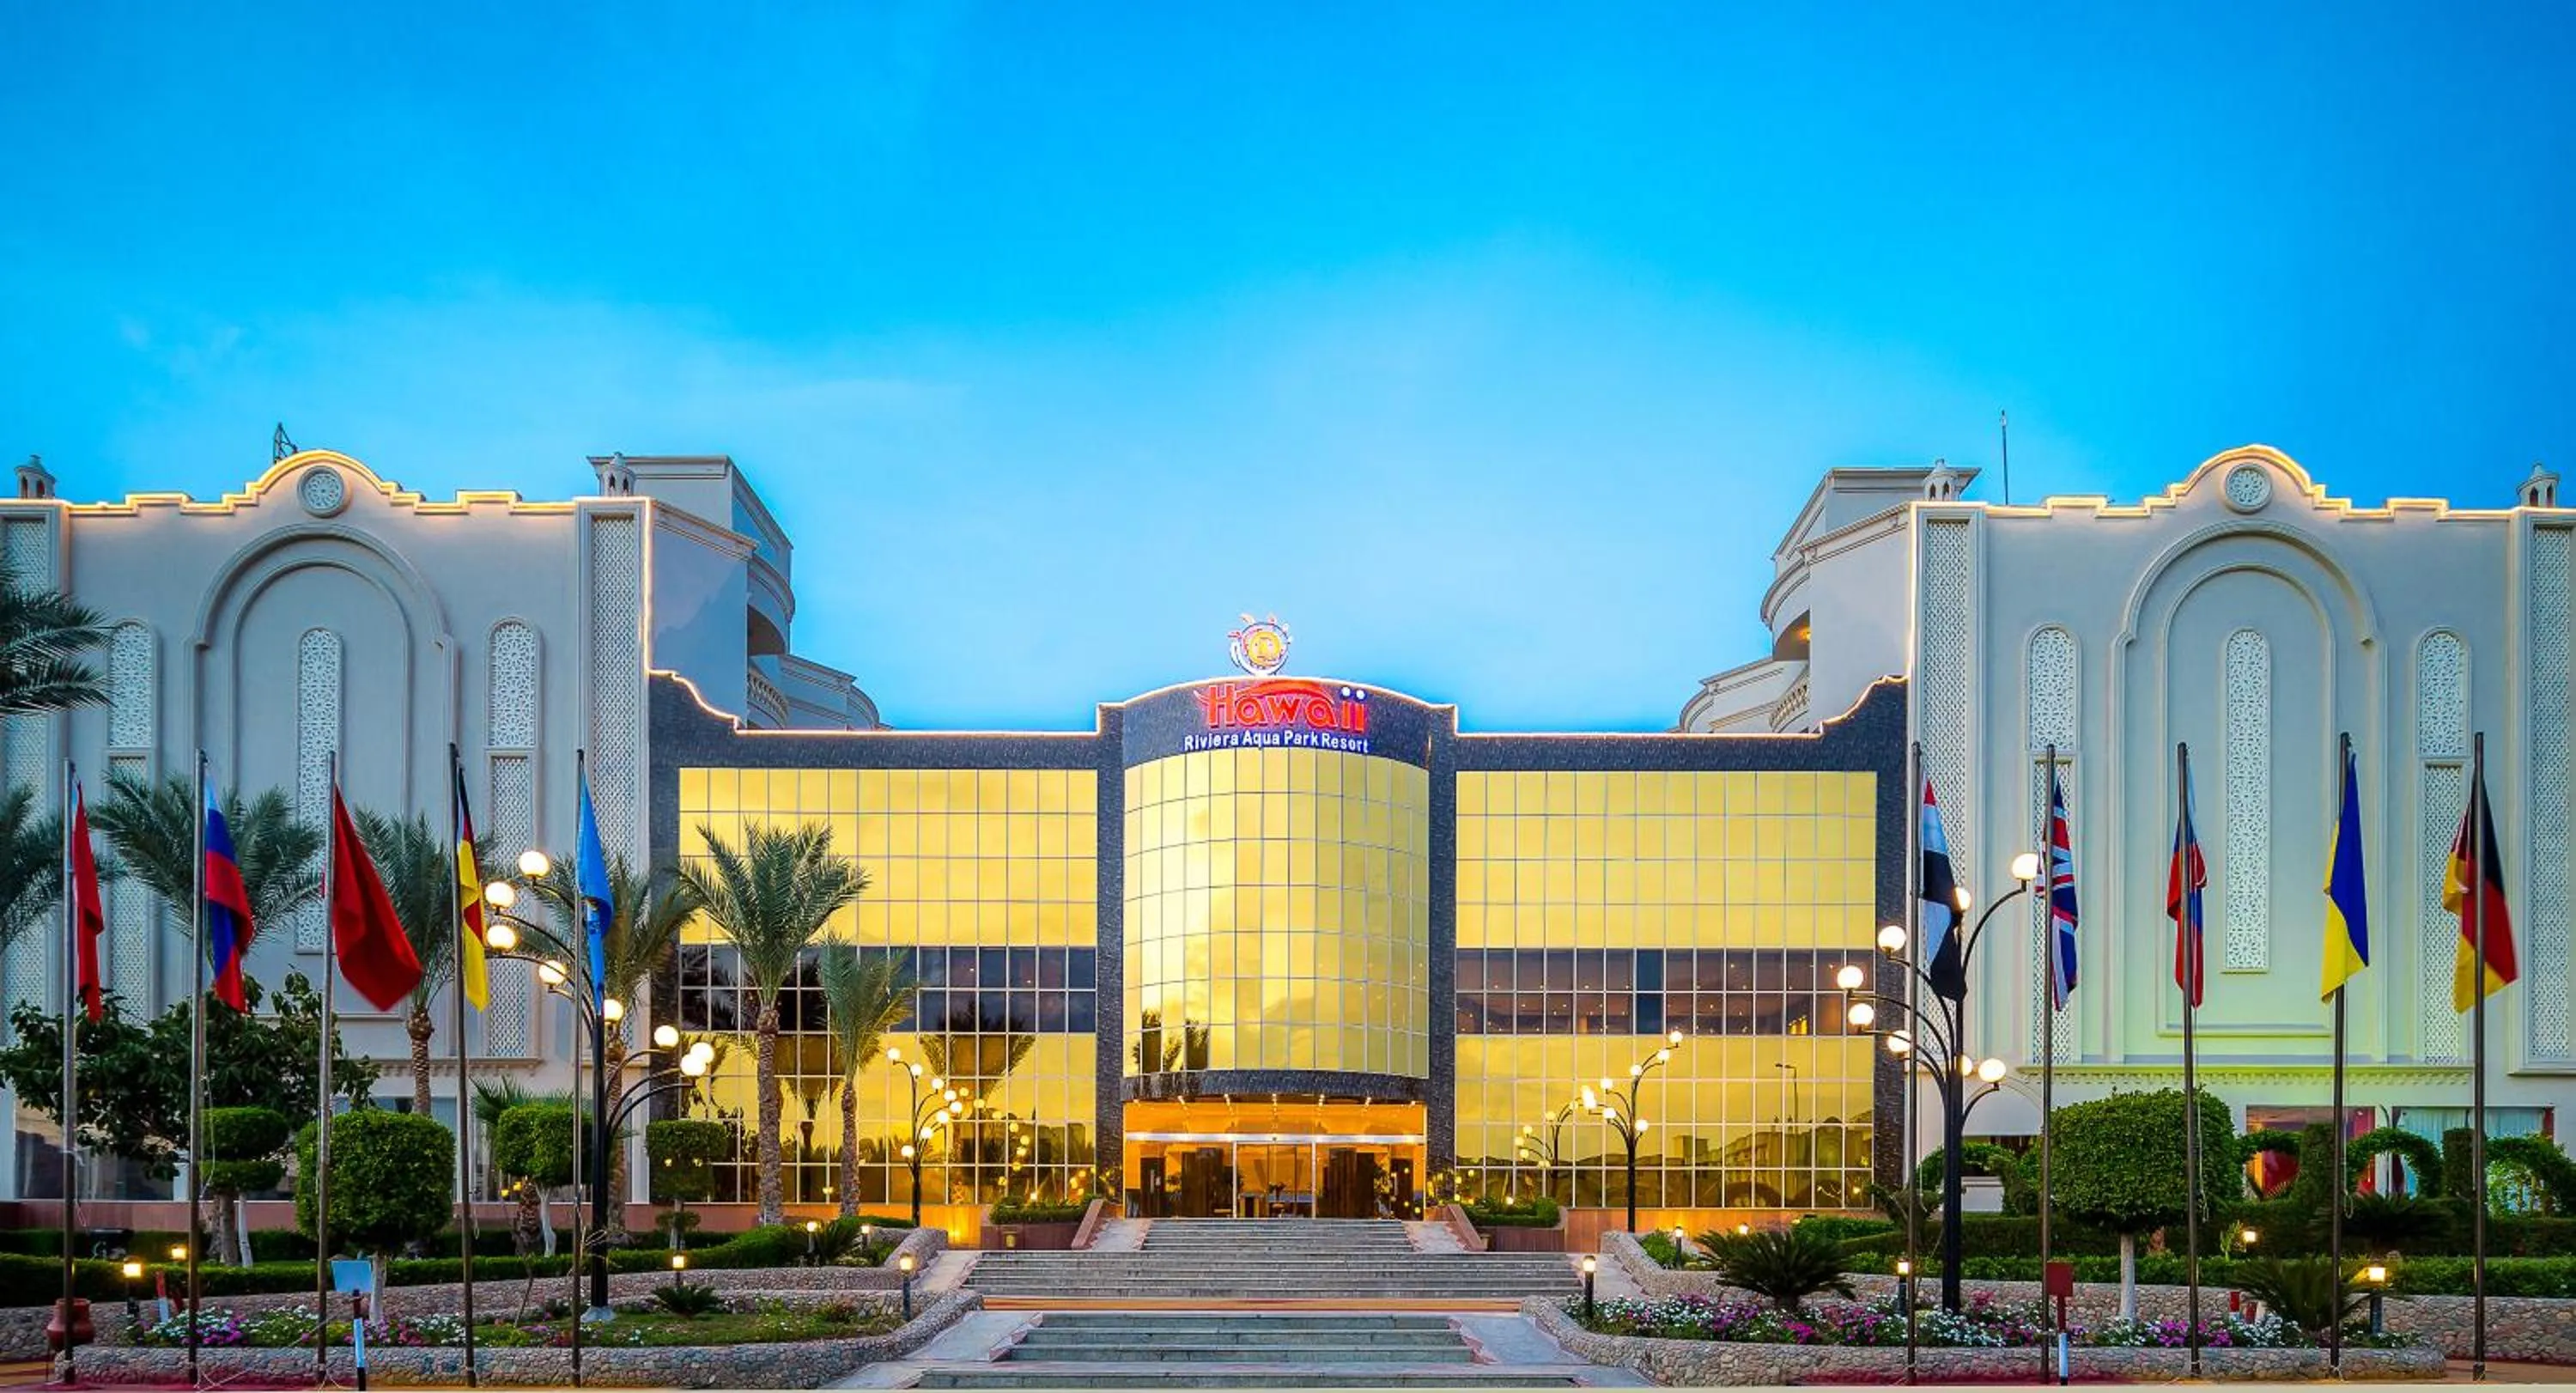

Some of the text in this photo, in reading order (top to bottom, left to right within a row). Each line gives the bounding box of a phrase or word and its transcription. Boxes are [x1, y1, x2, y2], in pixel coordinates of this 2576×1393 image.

[1194, 679, 1365, 732] Hawaii
[1184, 730, 1369, 753] Riviera Aqua Park Resort
